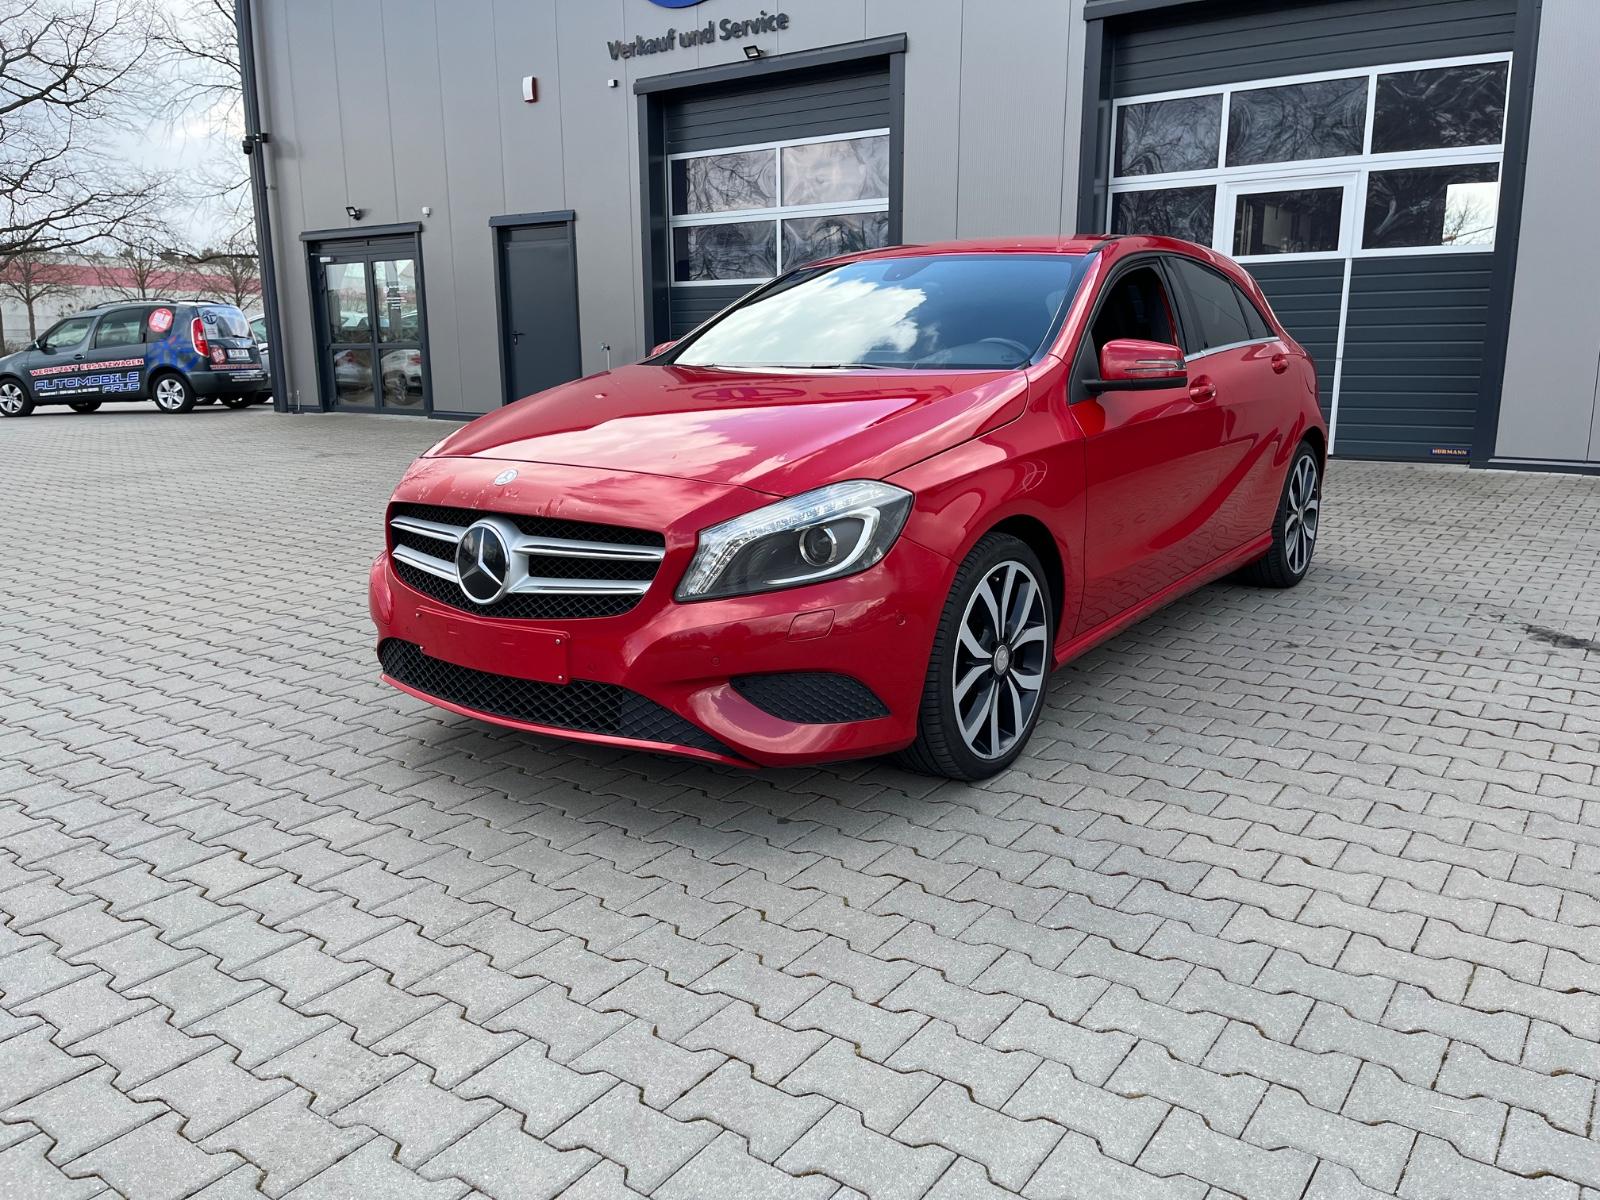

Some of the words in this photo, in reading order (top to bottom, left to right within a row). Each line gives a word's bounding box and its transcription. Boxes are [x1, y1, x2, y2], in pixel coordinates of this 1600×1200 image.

[607, 29, 676, 61] Verkauf
[679, 20, 715, 48] und
[720, 10, 789, 41] Service
[34, 371, 139, 390] AUTOMOBILE
